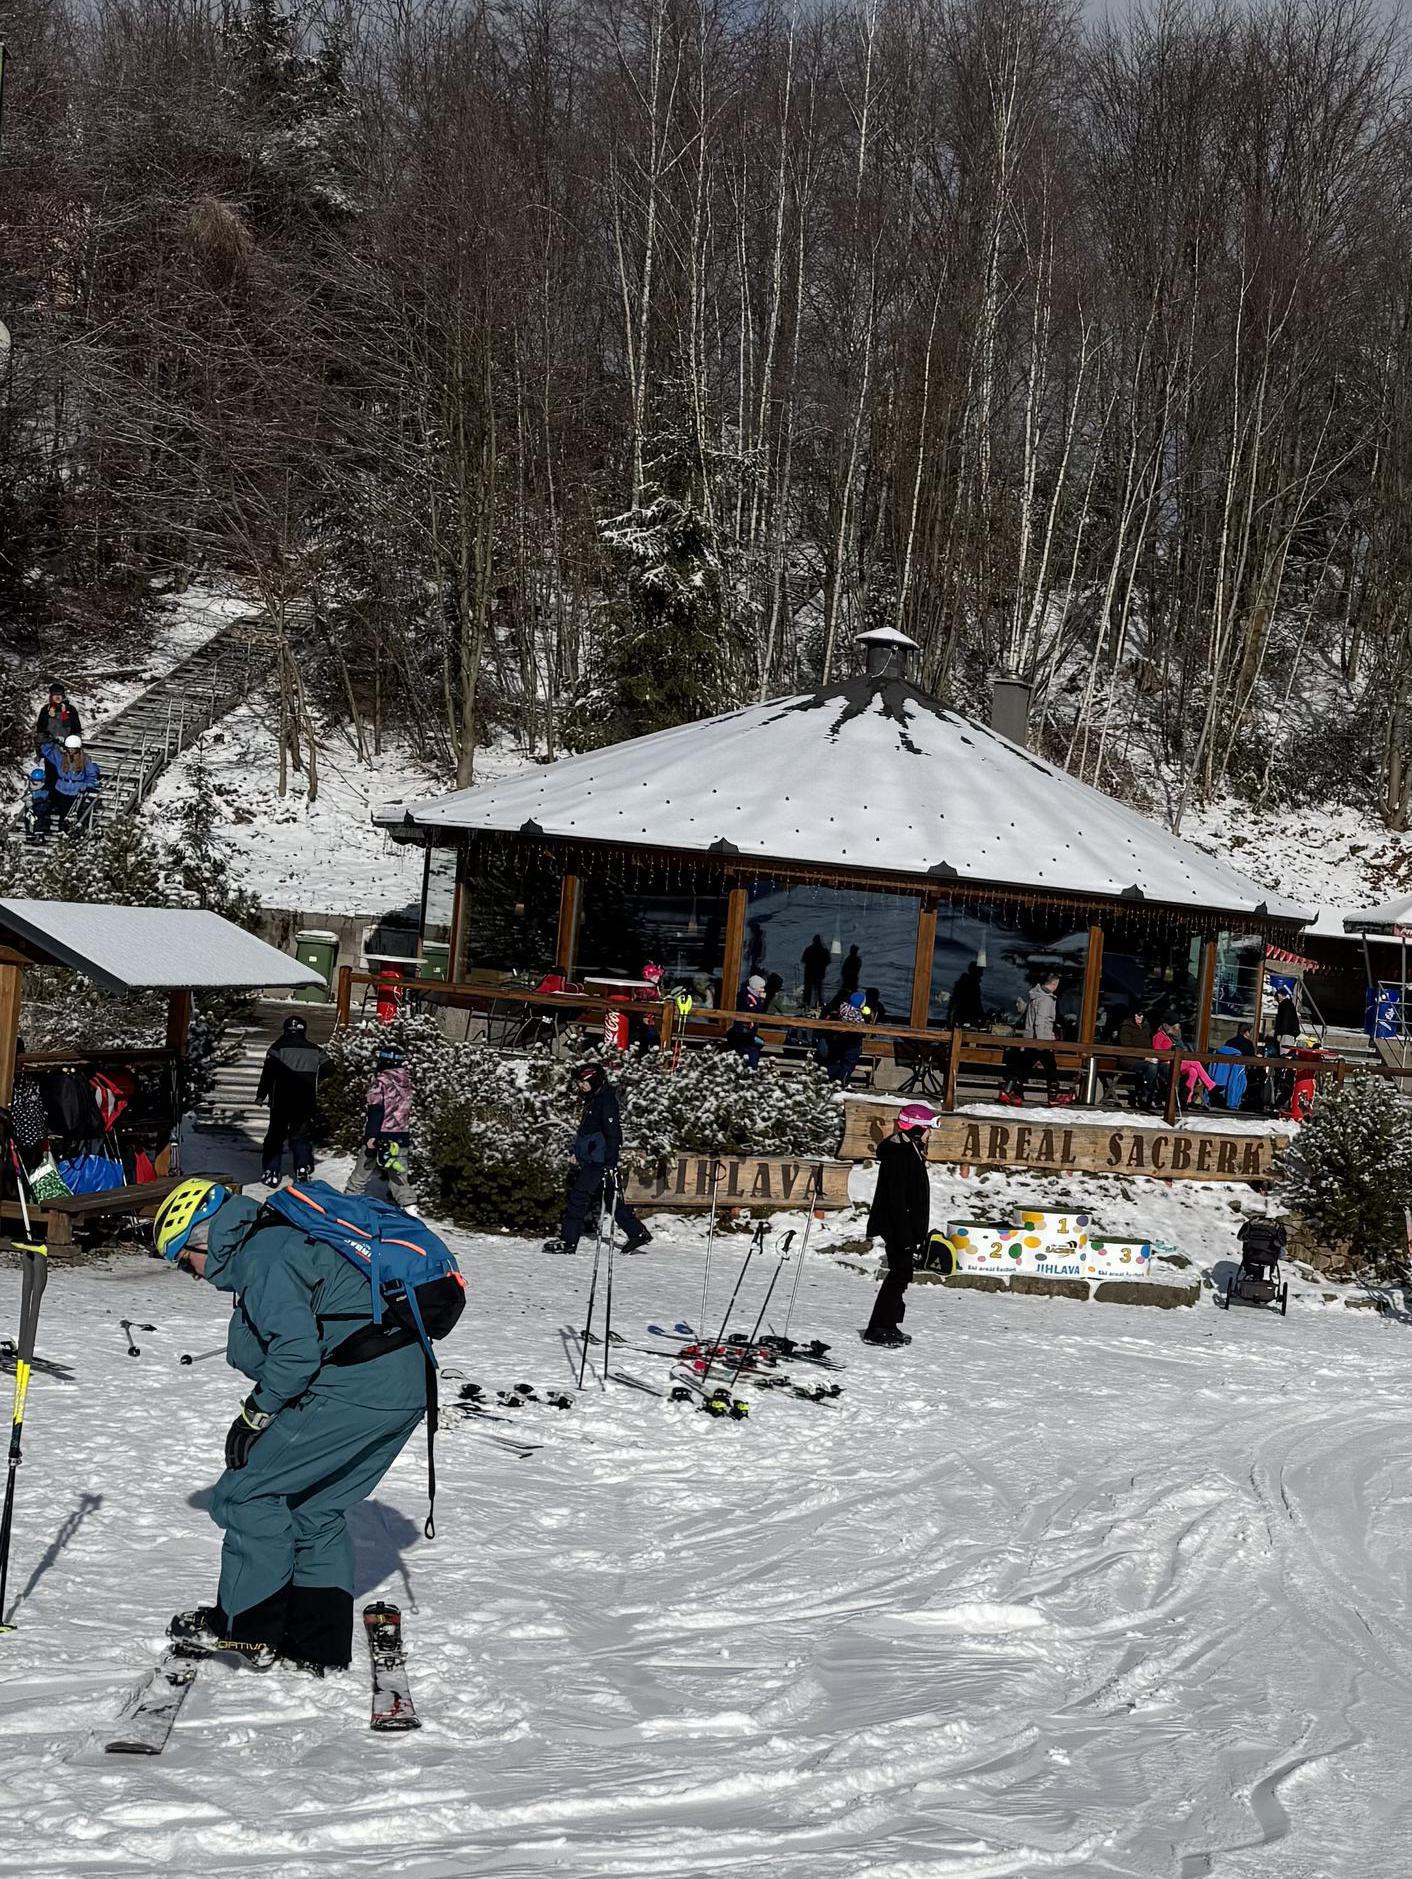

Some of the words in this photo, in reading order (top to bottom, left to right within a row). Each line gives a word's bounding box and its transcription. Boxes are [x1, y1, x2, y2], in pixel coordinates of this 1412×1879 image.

[961, 1123, 1076, 1164] AREAL
[1106, 1132, 1265, 1176] SACBERK
[650, 1157, 828, 1200] JIHLAVA
[1057, 1217, 1070, 1234] 1
[989, 1241, 1003, 1259] 2
[1119, 1247, 1132, 1264] 3
[1035, 1263, 1081, 1275] JIHLAVA
[216, 1640, 267, 1651] ORTIVA
